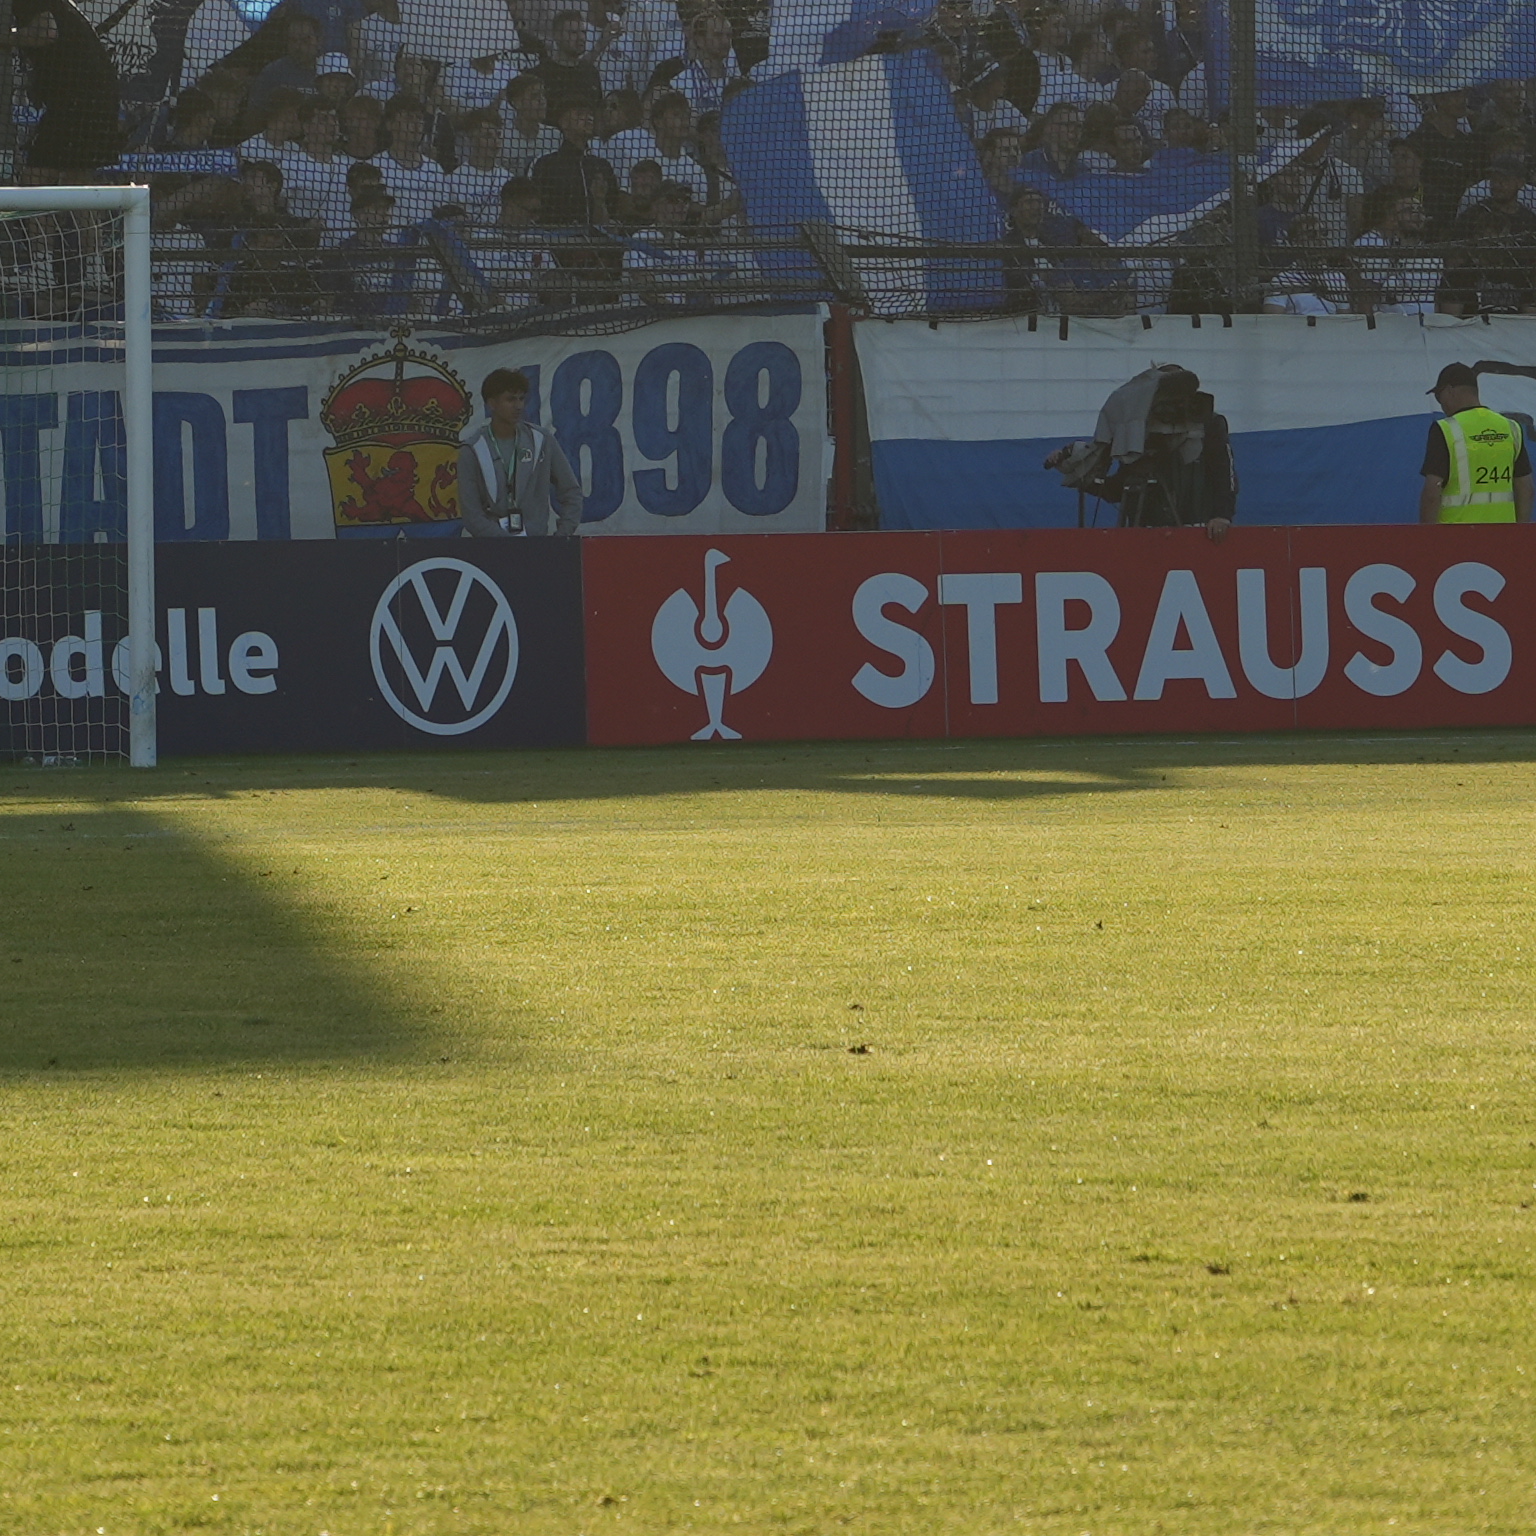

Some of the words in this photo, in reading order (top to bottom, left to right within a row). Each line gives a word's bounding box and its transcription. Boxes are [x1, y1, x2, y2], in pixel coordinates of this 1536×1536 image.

[484, 340, 803, 523] 898
[1475, 465, 1511, 485] 244
[850, 560, 1513, 709] STRAUSS
